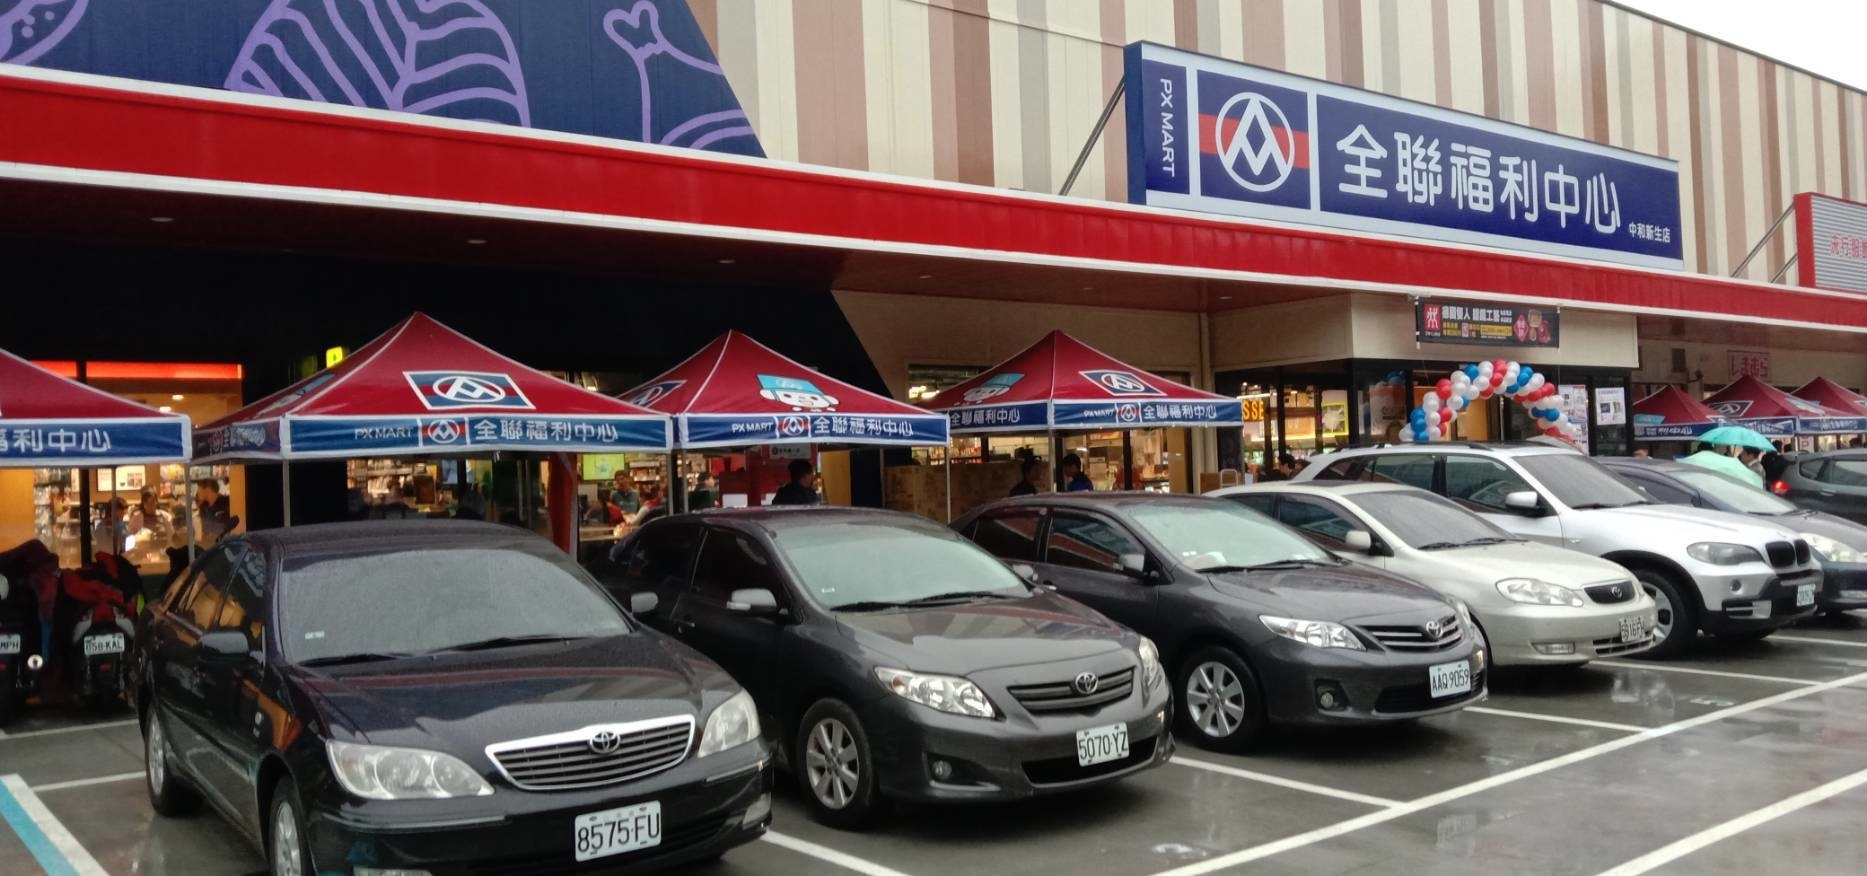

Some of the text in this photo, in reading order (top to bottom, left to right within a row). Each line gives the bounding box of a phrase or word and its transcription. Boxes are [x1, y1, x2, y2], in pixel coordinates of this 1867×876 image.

[1160, 78, 1175, 178] PX MART
[1335, 124, 1621, 234] 全聯福利中心
[1628, 221, 1671, 243] 中和新生店
[950, 408, 1020, 425] 全聯福利中心
[1143, 404, 1217, 419] 全聯福利中心
[354, 426, 412, 439] PX MART
[474, 419, 619, 443] 全聯福利中心
[731, 421, 774, 433] PX MART
[813, 416, 913, 437] 全聯福利中心
